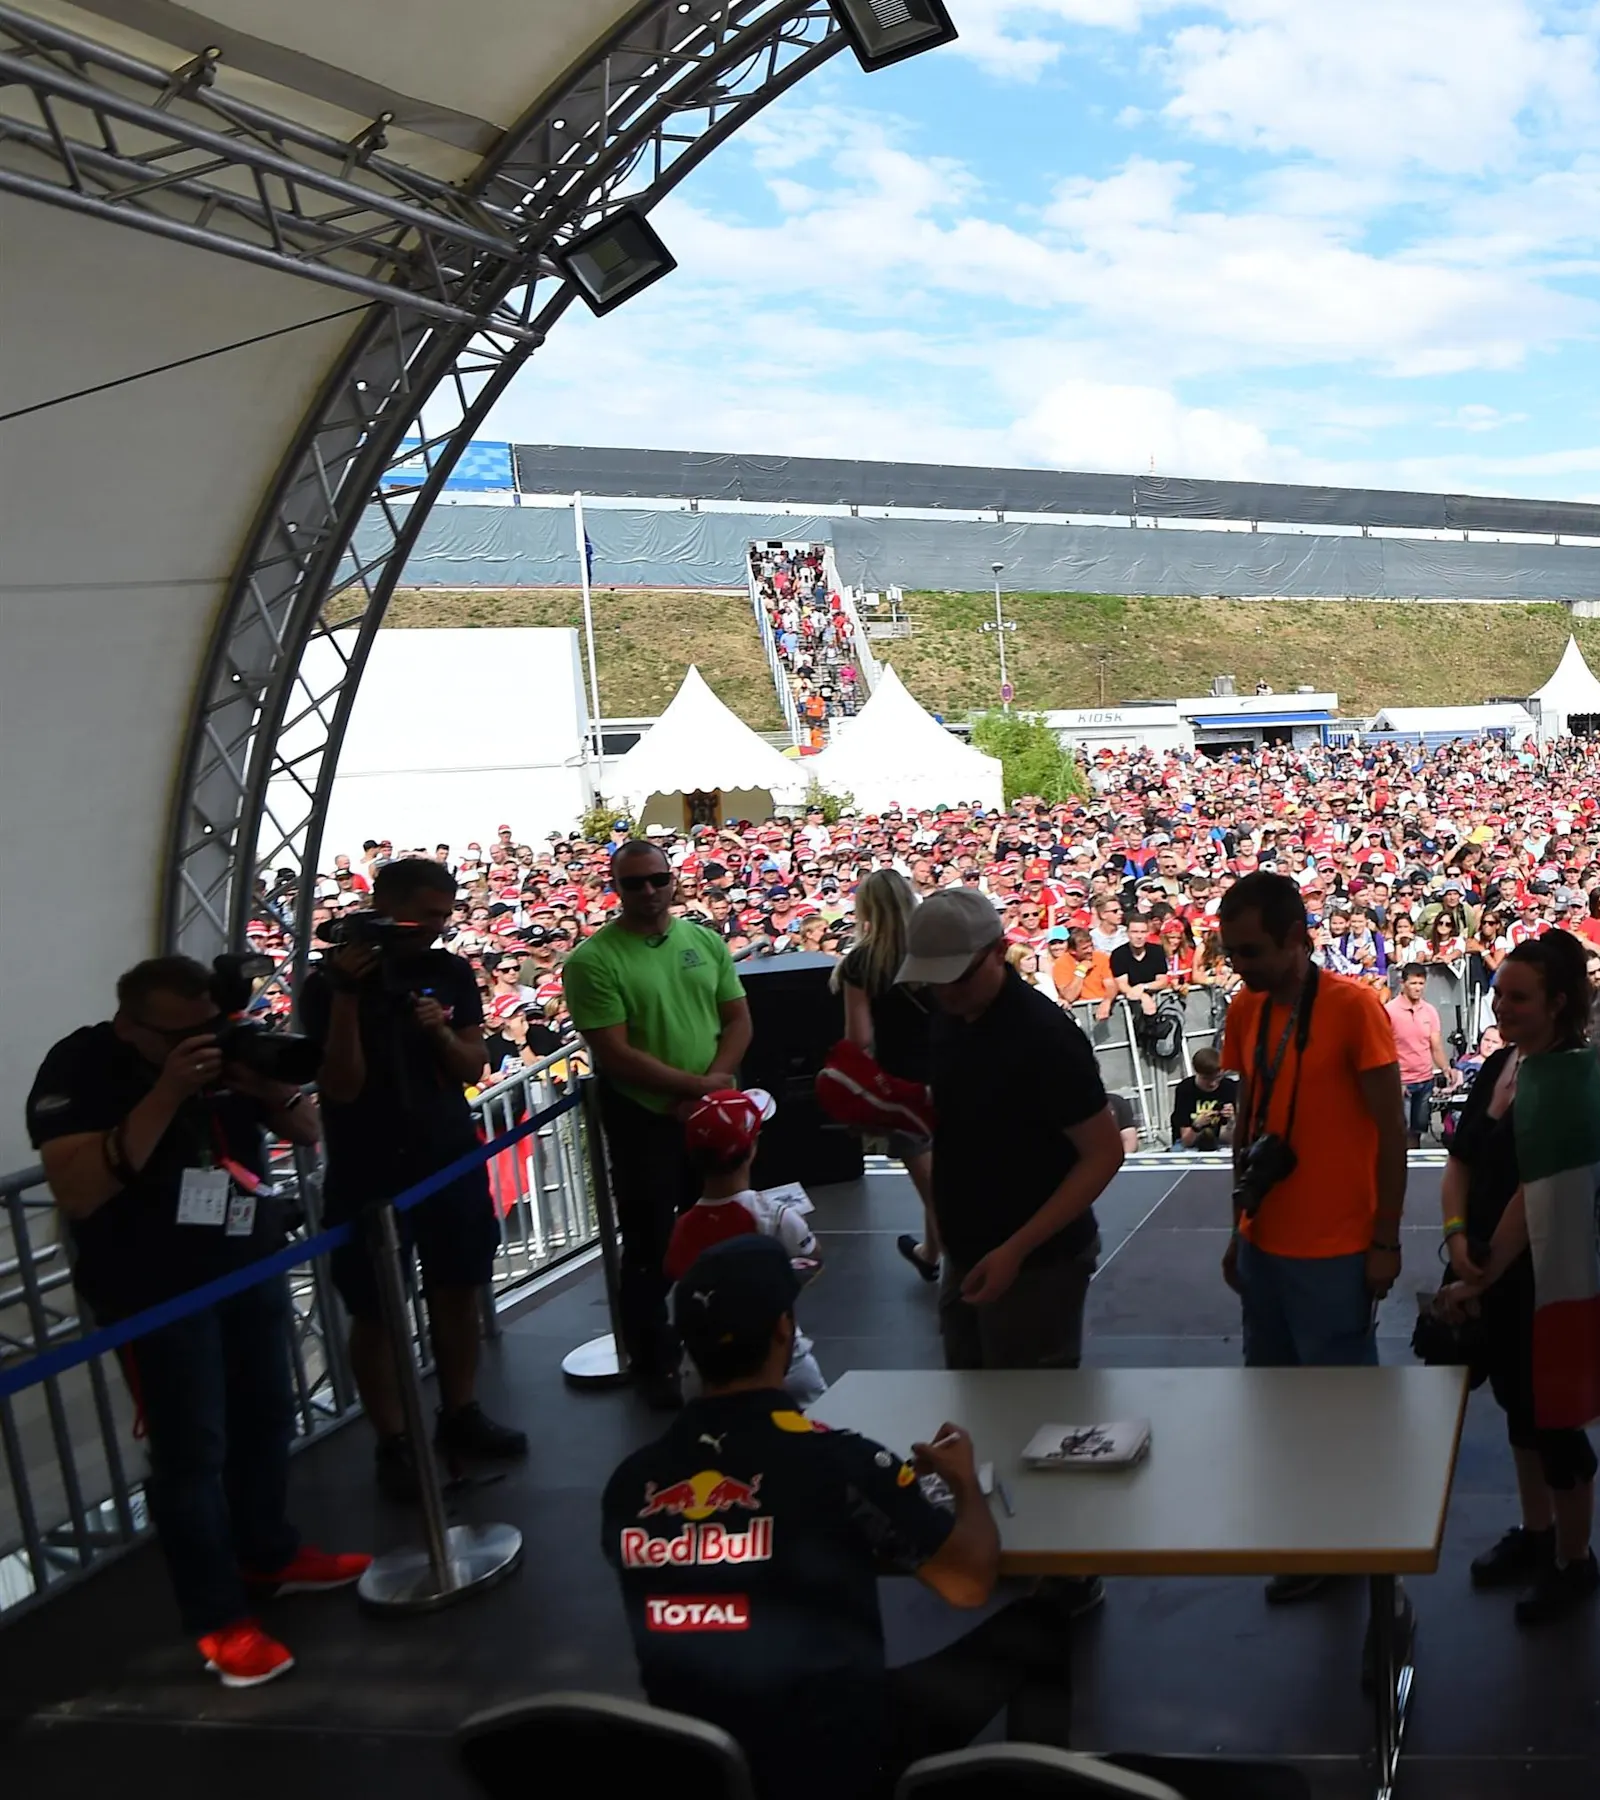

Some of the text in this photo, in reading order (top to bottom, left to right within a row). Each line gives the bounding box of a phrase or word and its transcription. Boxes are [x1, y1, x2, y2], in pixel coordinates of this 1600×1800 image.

[1078, 712, 1123, 723] KIOSK
[621, 1516, 774, 1569] Red Bull
[648, 1600, 747, 1625] TOTAL
